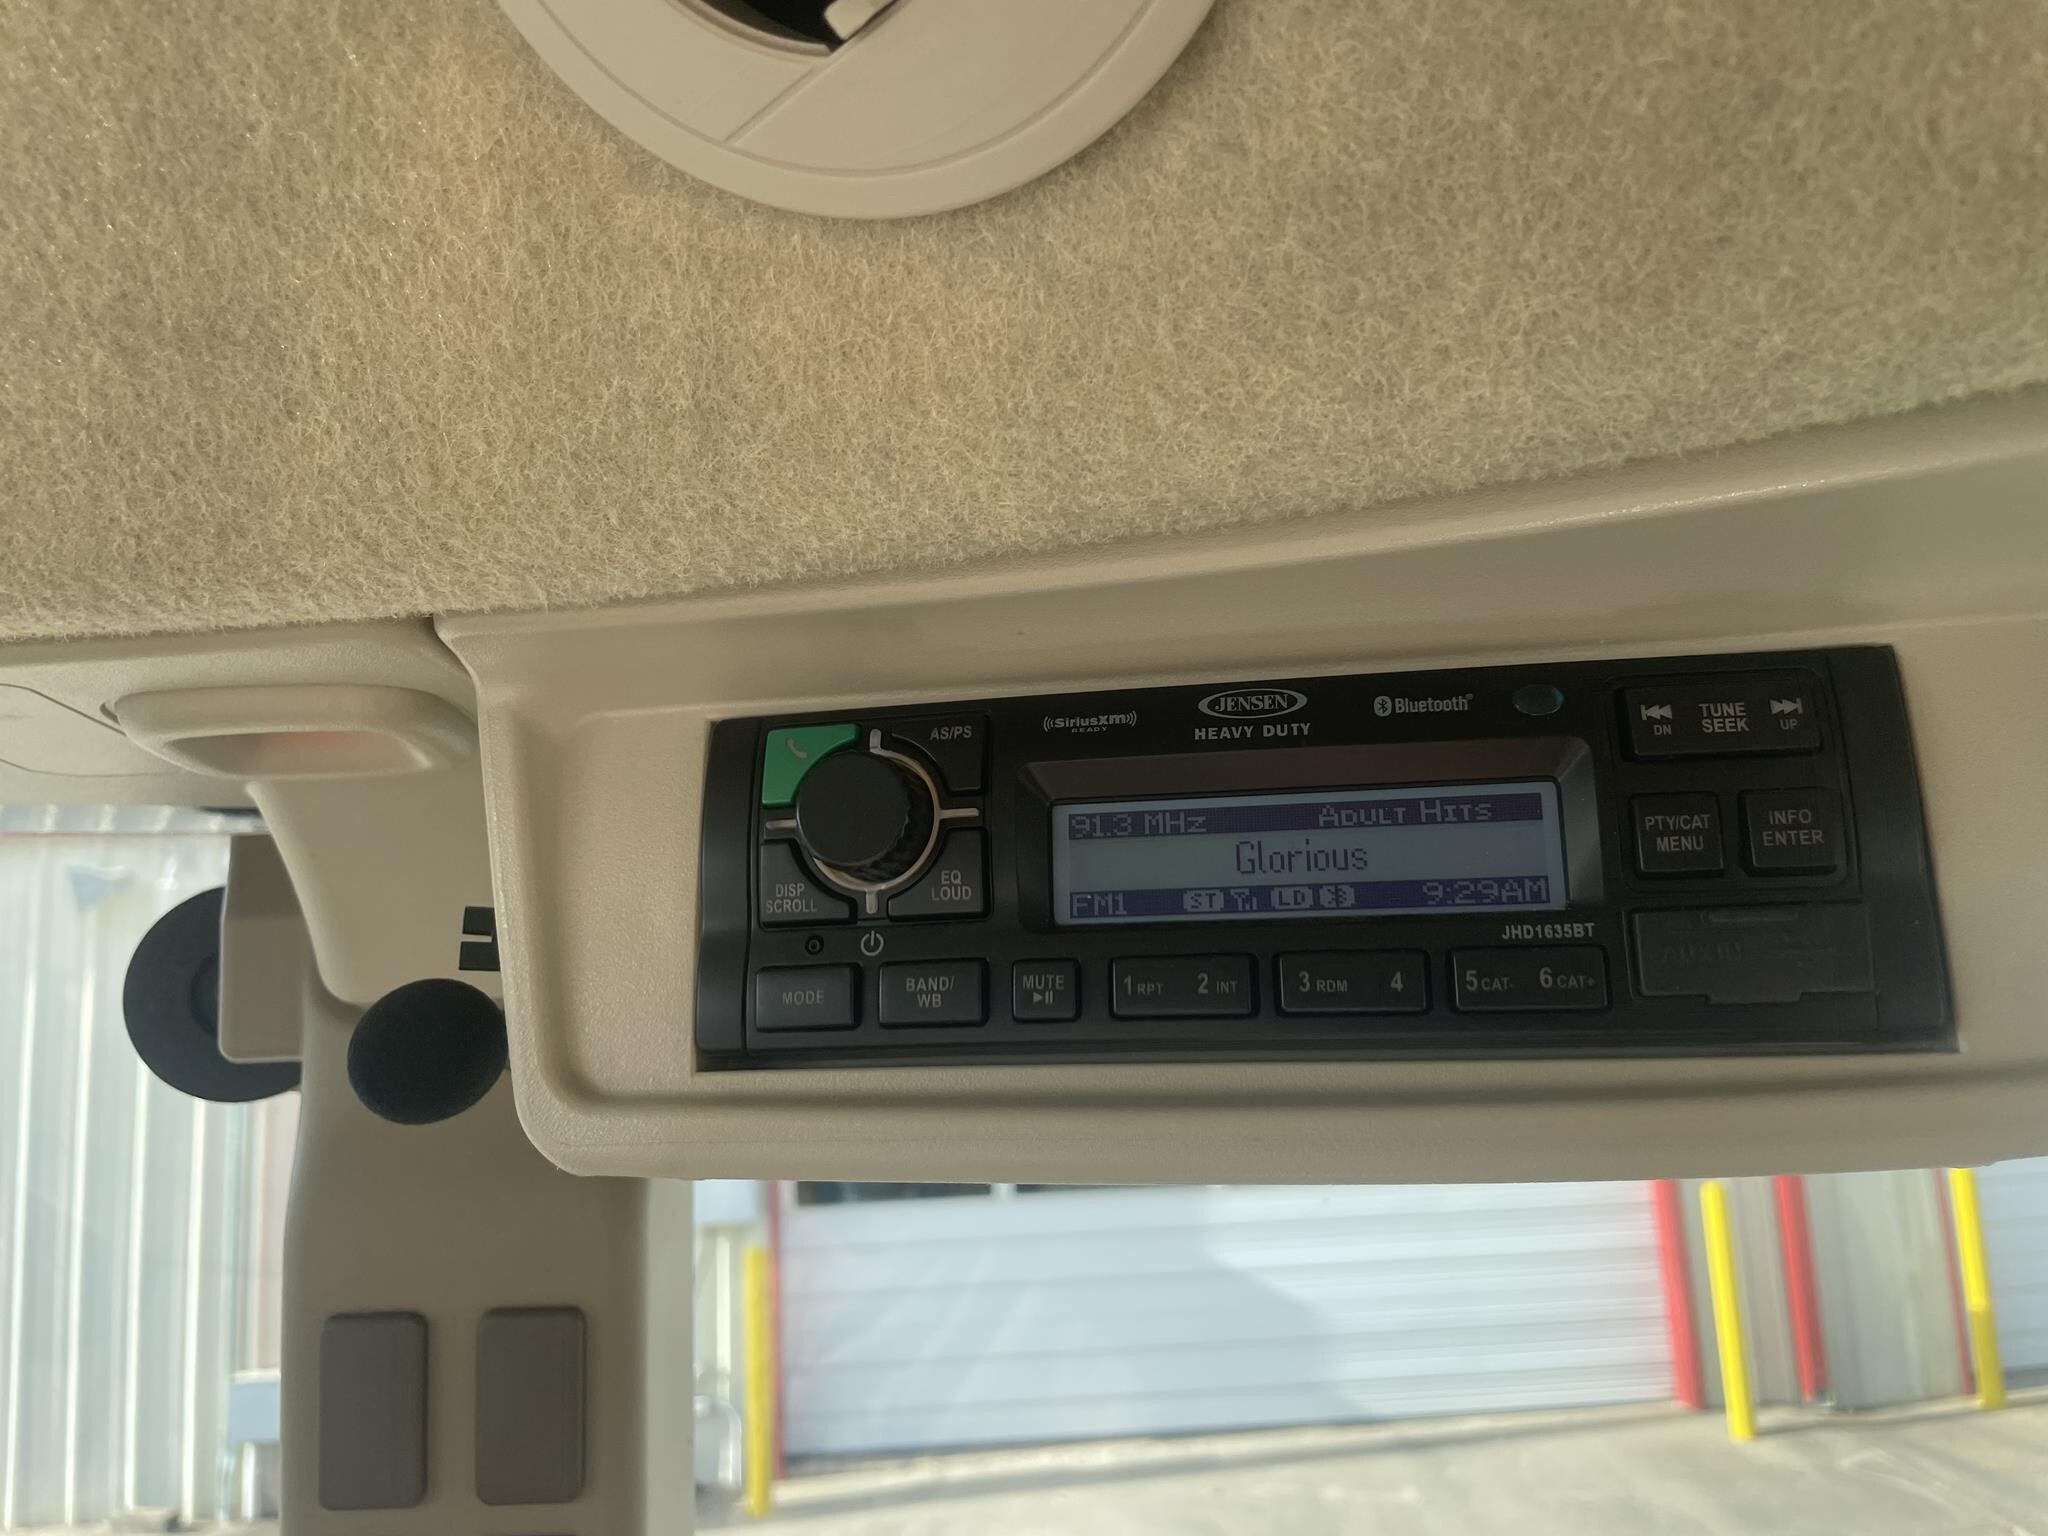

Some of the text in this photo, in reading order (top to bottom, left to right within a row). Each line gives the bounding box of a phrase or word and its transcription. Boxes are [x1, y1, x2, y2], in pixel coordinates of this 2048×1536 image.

[1215, 694, 1289, 712] JENSEN
[1394, 696, 1469, 713] Bluetooth
[1699, 702, 1747, 718] TUNE
[929, 725, 972, 741] AS/PS
[1194, 723, 1311, 740] HEAVY DUTY
[1653, 724, 1673, 736] DN
[1702, 718, 1749, 733] SEEK
[1780, 718, 1799, 731] UP
[1071, 811, 1207, 838] 91.3 MHz
[1644, 814, 1711, 831] PTY/CAT
[1768, 809, 1812, 824] INFO
[1656, 835, 1704, 852] MENU
[1763, 830, 1824, 846] ENTER
[1236, 838, 1368, 874] Glorious
[940, 870, 962, 886] EQ
[775, 883, 806, 898] DISP
[931, 885, 972, 901] LOUD
[1278, 889, 1306, 906] LD
[766, 899, 818, 913] SCROLL
[1072, 893, 1127, 915] FM1
[1190, 892, 1217, 909] ST
[1501, 923, 1597, 940] JHD1635BT
[906, 976, 955, 992] BAND/
[1022, 974, 1064, 990] MUTE
[1123, 975, 1163, 995] 1 RPT
[1197, 973, 1237, 994] 2 INT
[1299, 971, 1348, 993] 3 RDM
[1390, 971, 1403, 991] 4
[1465, 970, 1477, 991] 5
[1539, 966, 1553, 989] 6
[782, 990, 824, 1004] MODE
[917, 994, 942, 1008] WB
